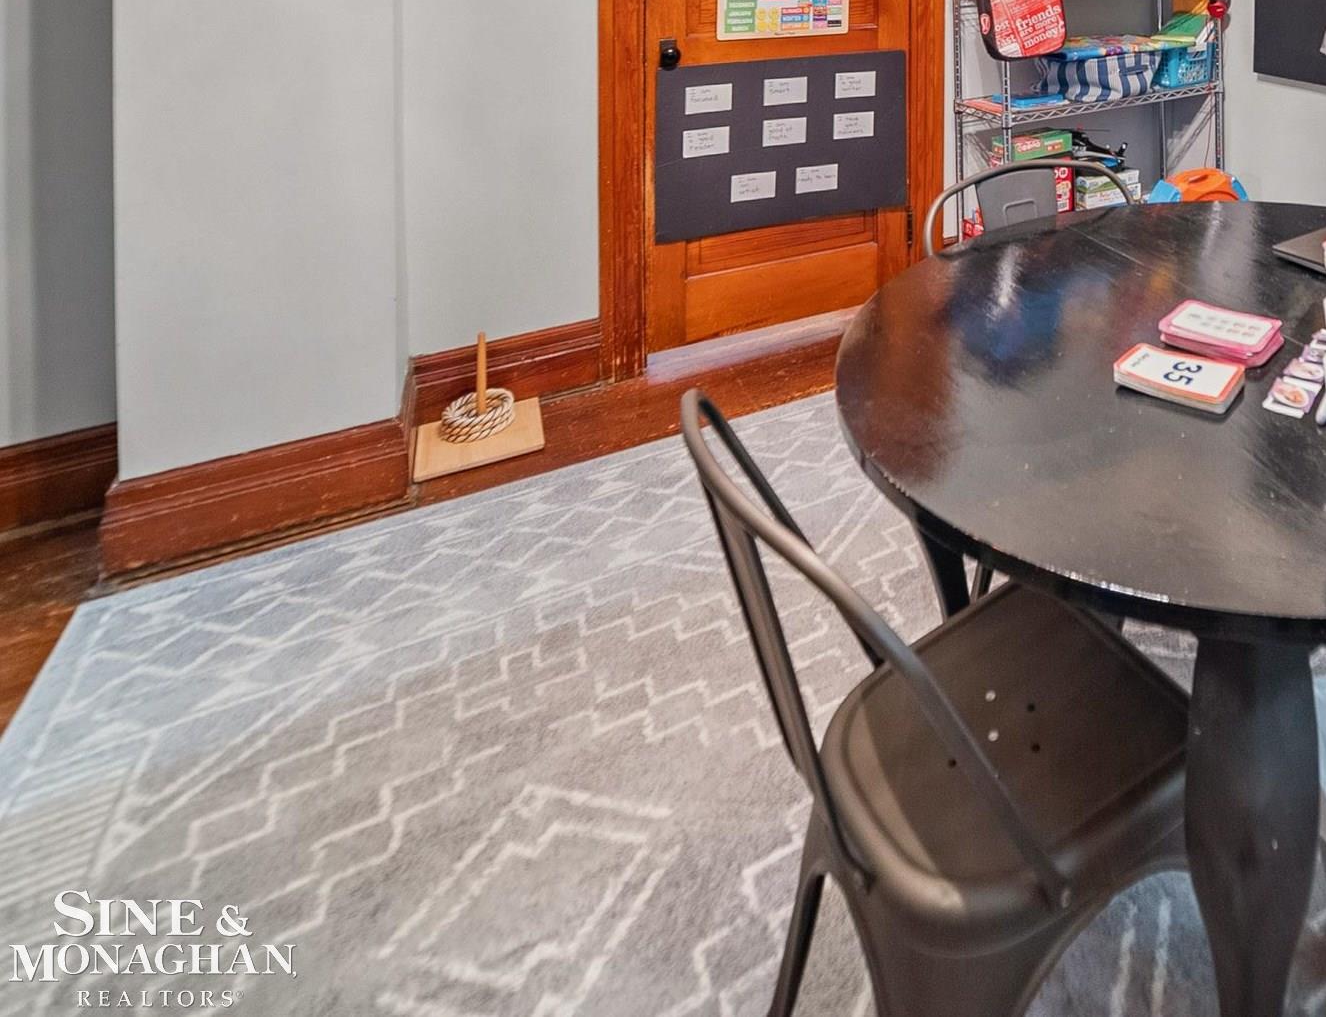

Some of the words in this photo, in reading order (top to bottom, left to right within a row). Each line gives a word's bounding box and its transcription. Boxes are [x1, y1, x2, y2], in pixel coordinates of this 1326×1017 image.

[1015, 4, 1062, 31] friends
[1019, 26, 1034, 38] are
[1034, 16, 1057, 30] more
[1163, 361, 1203, 386] 35
